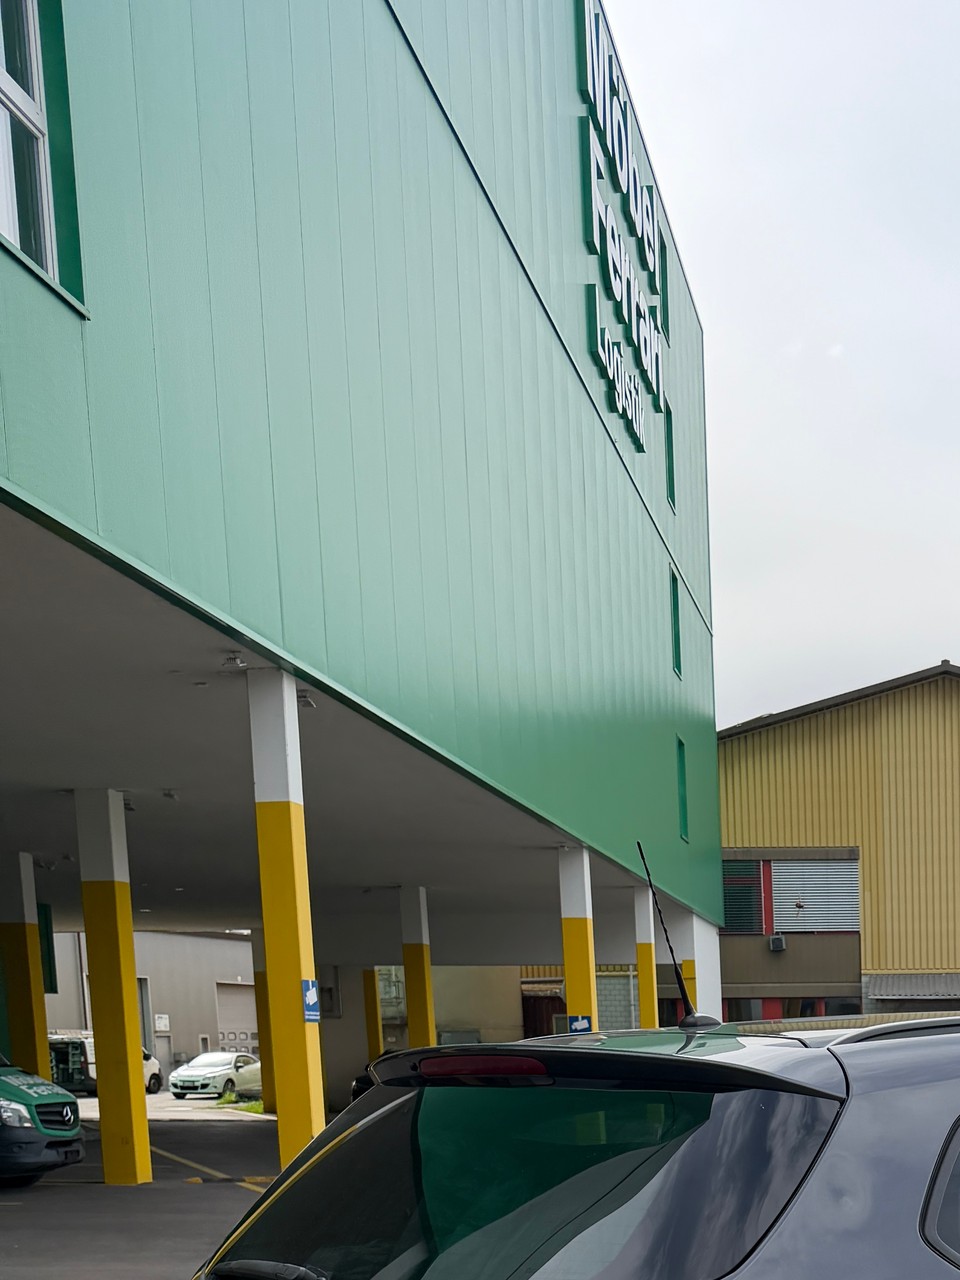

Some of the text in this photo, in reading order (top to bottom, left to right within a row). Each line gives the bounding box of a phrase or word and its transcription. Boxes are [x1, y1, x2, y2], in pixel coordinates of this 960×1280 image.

[584, 0, 660, 295] Möbel
[589, 115, 664, 413] Ferrari
[596, 284, 646, 453] Logistik
